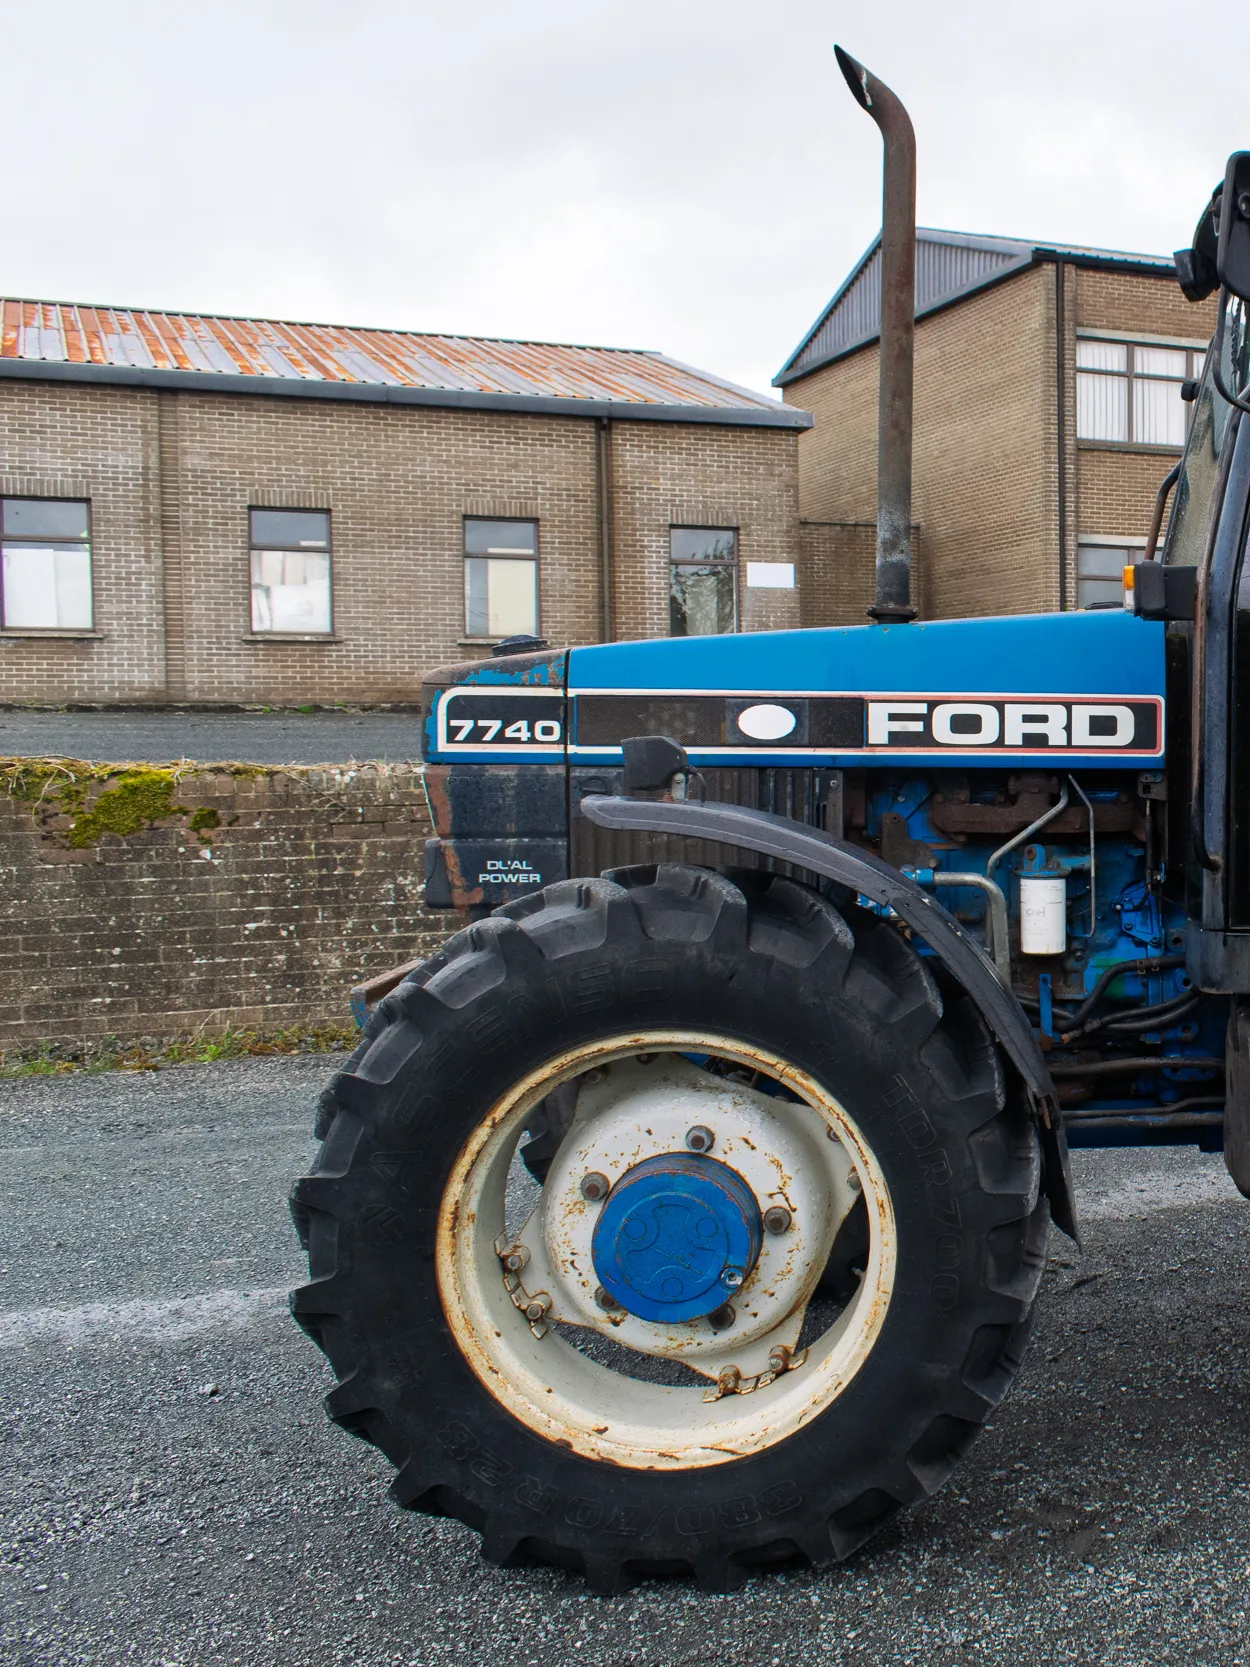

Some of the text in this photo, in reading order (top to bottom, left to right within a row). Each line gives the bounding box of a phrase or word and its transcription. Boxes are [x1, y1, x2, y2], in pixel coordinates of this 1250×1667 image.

[449, 719, 561, 743] 7740
[868, 702, 1136, 746] FORD
[479, 873, 541, 883] POWER
[369, 957, 677, 1197] ASCENSO
[882, 1073, 953, 1188] TDR
[928, 1197, 964, 1312] 700
[563, 1479, 803, 1536] 380/70
